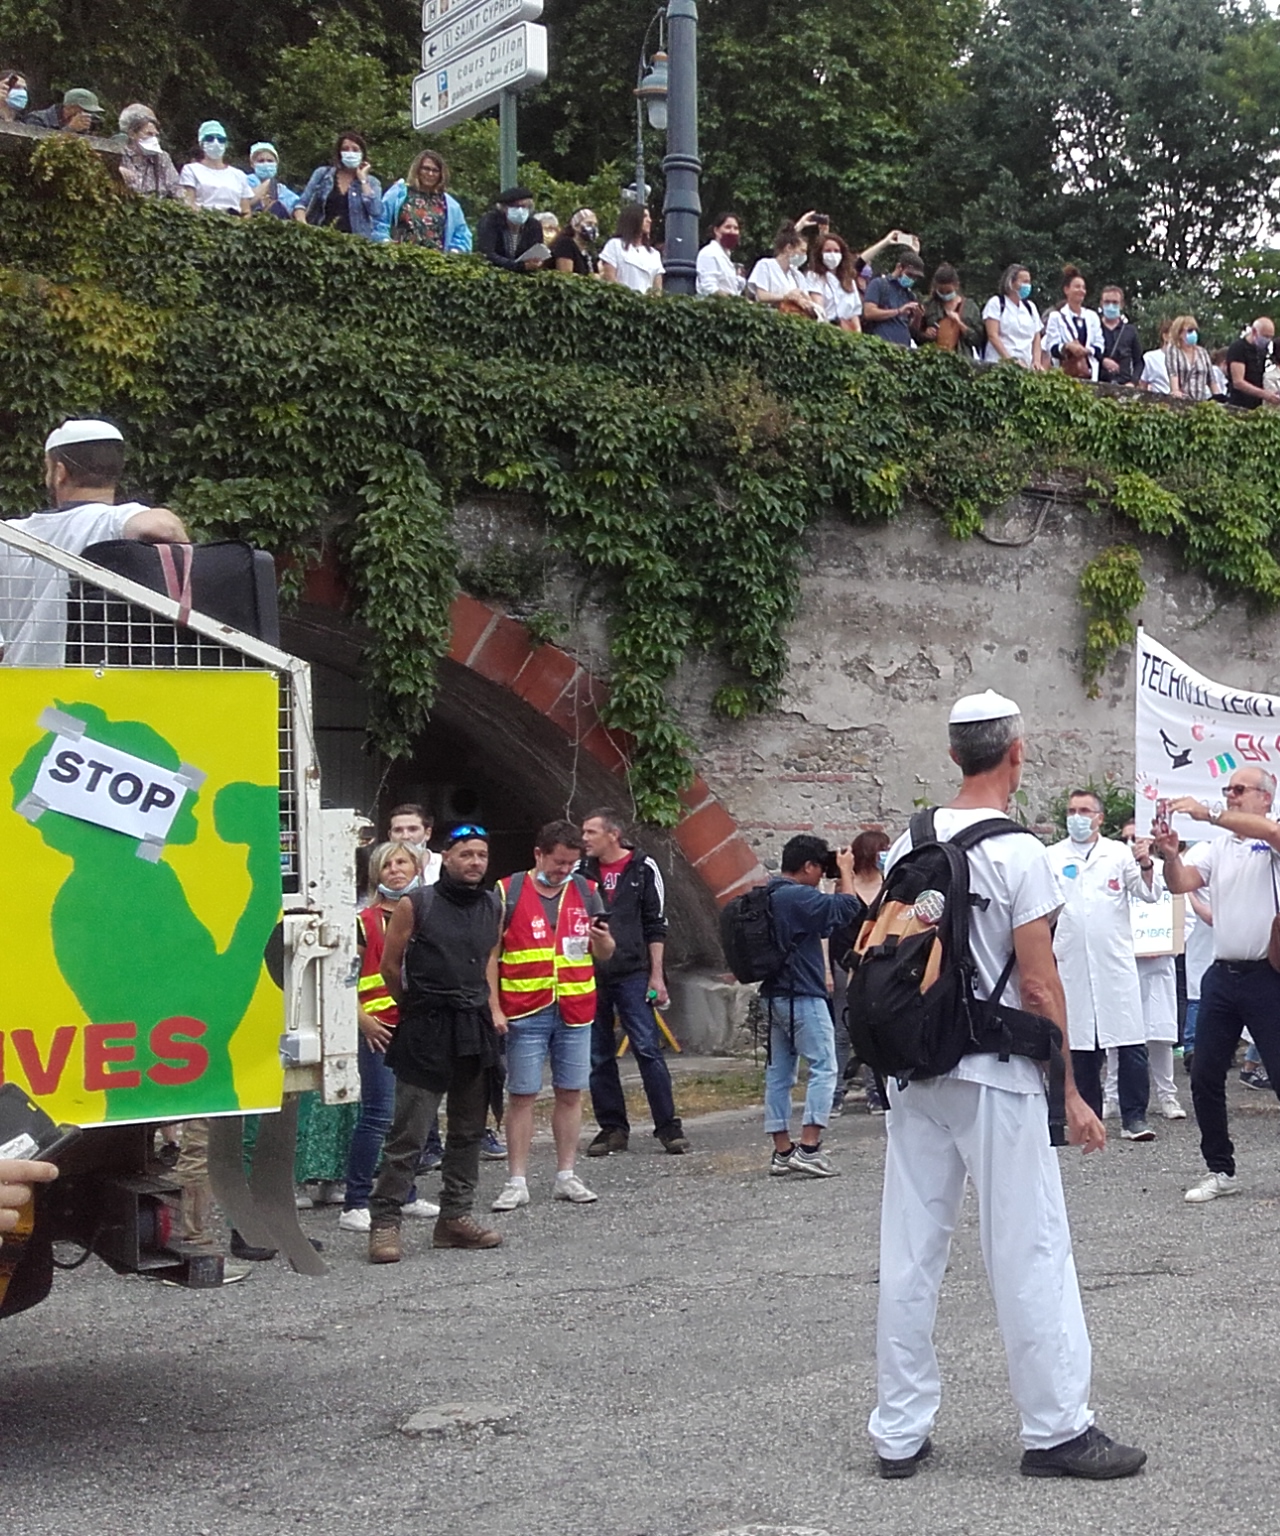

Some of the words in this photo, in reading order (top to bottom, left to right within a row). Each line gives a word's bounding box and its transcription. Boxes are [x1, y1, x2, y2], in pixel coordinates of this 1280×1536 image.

[455, 14, 480, 41] SAINT
[457, 57, 484, 80] cours
[490, 37, 523, 62] Dillon
[1235, 733, 1270, 762] EN
[48, 750, 176, 813] STOP
[0, 1016, 208, 1096] VES
